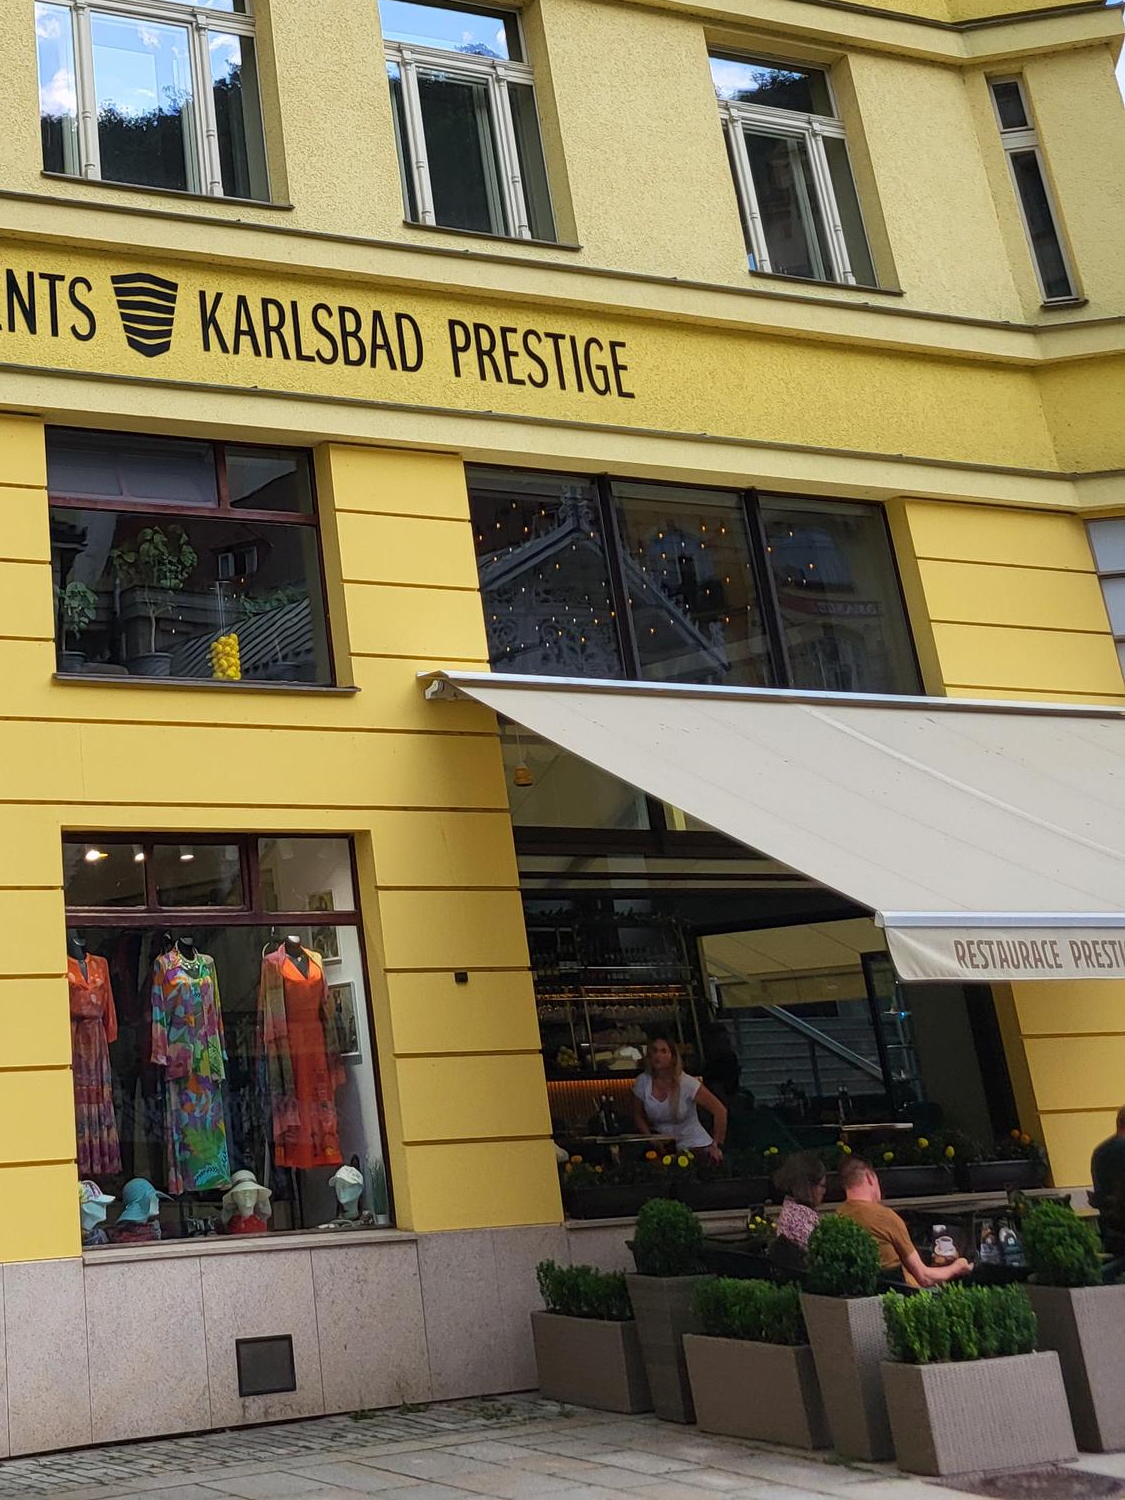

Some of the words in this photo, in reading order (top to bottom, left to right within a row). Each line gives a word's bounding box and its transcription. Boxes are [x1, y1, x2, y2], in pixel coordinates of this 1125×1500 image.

[198, 290, 424, 373] KARLSBAD
[447, 319, 636, 399] PRESTIGE
[954, 940, 1063, 969] RESTAURACE
[1068, 940, 1125, 969] PRESTI
